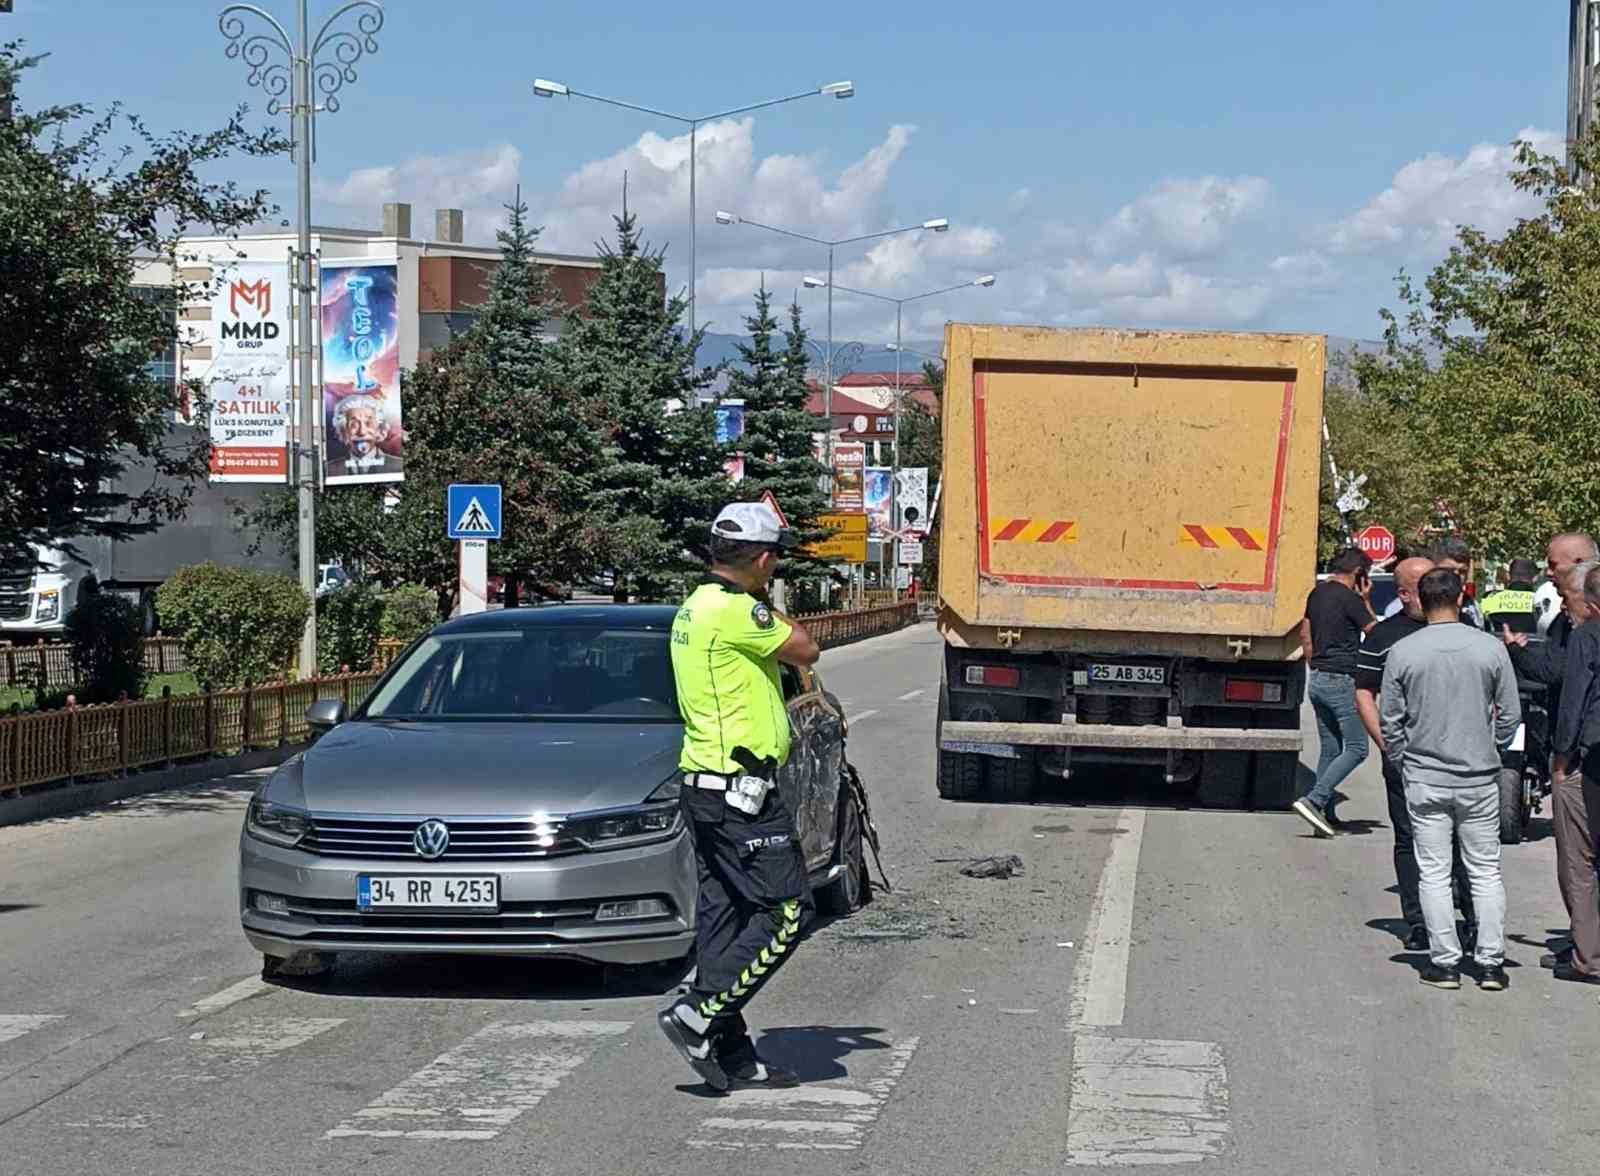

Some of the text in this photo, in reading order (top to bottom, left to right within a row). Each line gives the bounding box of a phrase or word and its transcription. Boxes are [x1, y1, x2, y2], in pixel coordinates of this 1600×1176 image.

[221, 321, 279, 339] MMD
[237, 341, 263, 349] GRUP
[238, 385, 262, 397] 4+1
[217, 400, 281, 414] SATILIK
[1362, 537, 1392, 551] DUR
[1093, 666, 1163, 681] 25 AB 345
[371, 880, 395, 903] 34
[407, 880, 432, 903] RR
[444, 880, 494, 903] 4253
